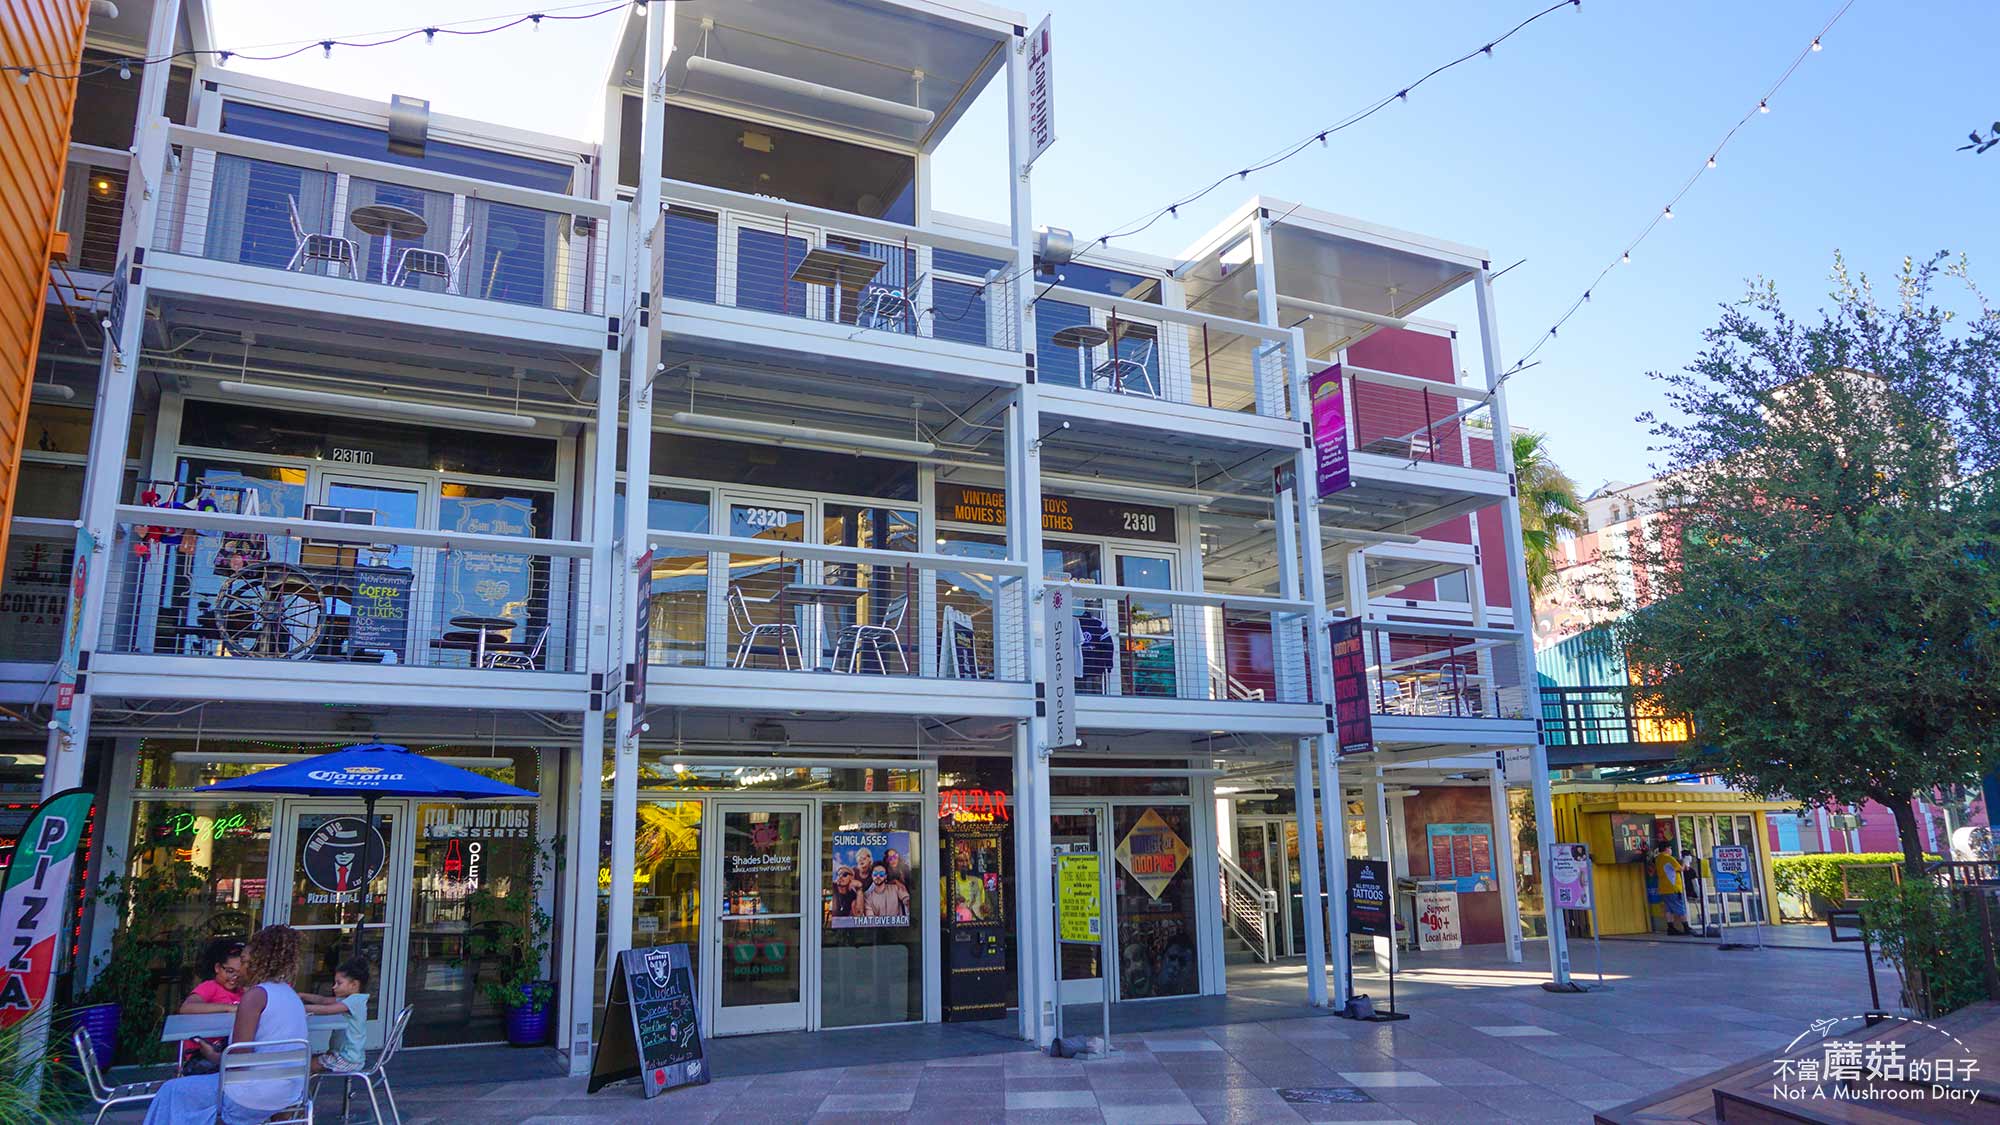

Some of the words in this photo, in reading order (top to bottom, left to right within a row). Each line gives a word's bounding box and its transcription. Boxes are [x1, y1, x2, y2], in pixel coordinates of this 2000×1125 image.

[1035, 61, 1048, 149] CONTAINER
[333, 448, 374, 465] 2310
[962, 490, 1005, 508] VINTAGE
[1043, 498, 1069, 514] TOYS
[746, 507, 788, 528] 2320
[955, 505, 993, 523] MOVIES
[1041, 513, 1073, 532] OTHES
[1123, 511, 1157, 533] 2330
[0, 593, 66, 614] CONTAI
[20, 616, 62, 625] PAR
[1054, 620, 1063, 681] Shades
[1056, 686, 1064, 745] Deluxe
[308, 769, 406, 782] Corona
[938, 788, 1009, 822] ZOLTAR
[165, 812, 247, 841] Pizza
[476, 808, 499, 828] HOT
[500, 809, 530, 828] DOGS
[431, 828, 529, 838] DESSERTS
[834, 835, 888, 847] SUNGLASSES
[1074, 844, 1089, 853] OPEN
[468, 841, 482, 890] OPEN
[732, 854, 761, 866] Shades
[762, 853, 792, 865] Deluxe
[1130, 855, 1153, 873] 1000
[1153, 854, 1176, 872] PINS
[307, 892, 329, 904] Pizza
[1352, 887, 1384, 900] TATTOOS
[0, 815, 68, 1010] PIZZA
[1426, 904, 1450, 914] Support
[854, 915, 875, 926] THAT
[874, 915, 891, 925] GIVE
[891, 915, 910, 925] BACK
[1430, 914, 1450, 931] 90+
[1425, 933, 1442, 943] Local
[1442, 932, 1458, 942] Artist
[635, 973, 683, 1001] Student
